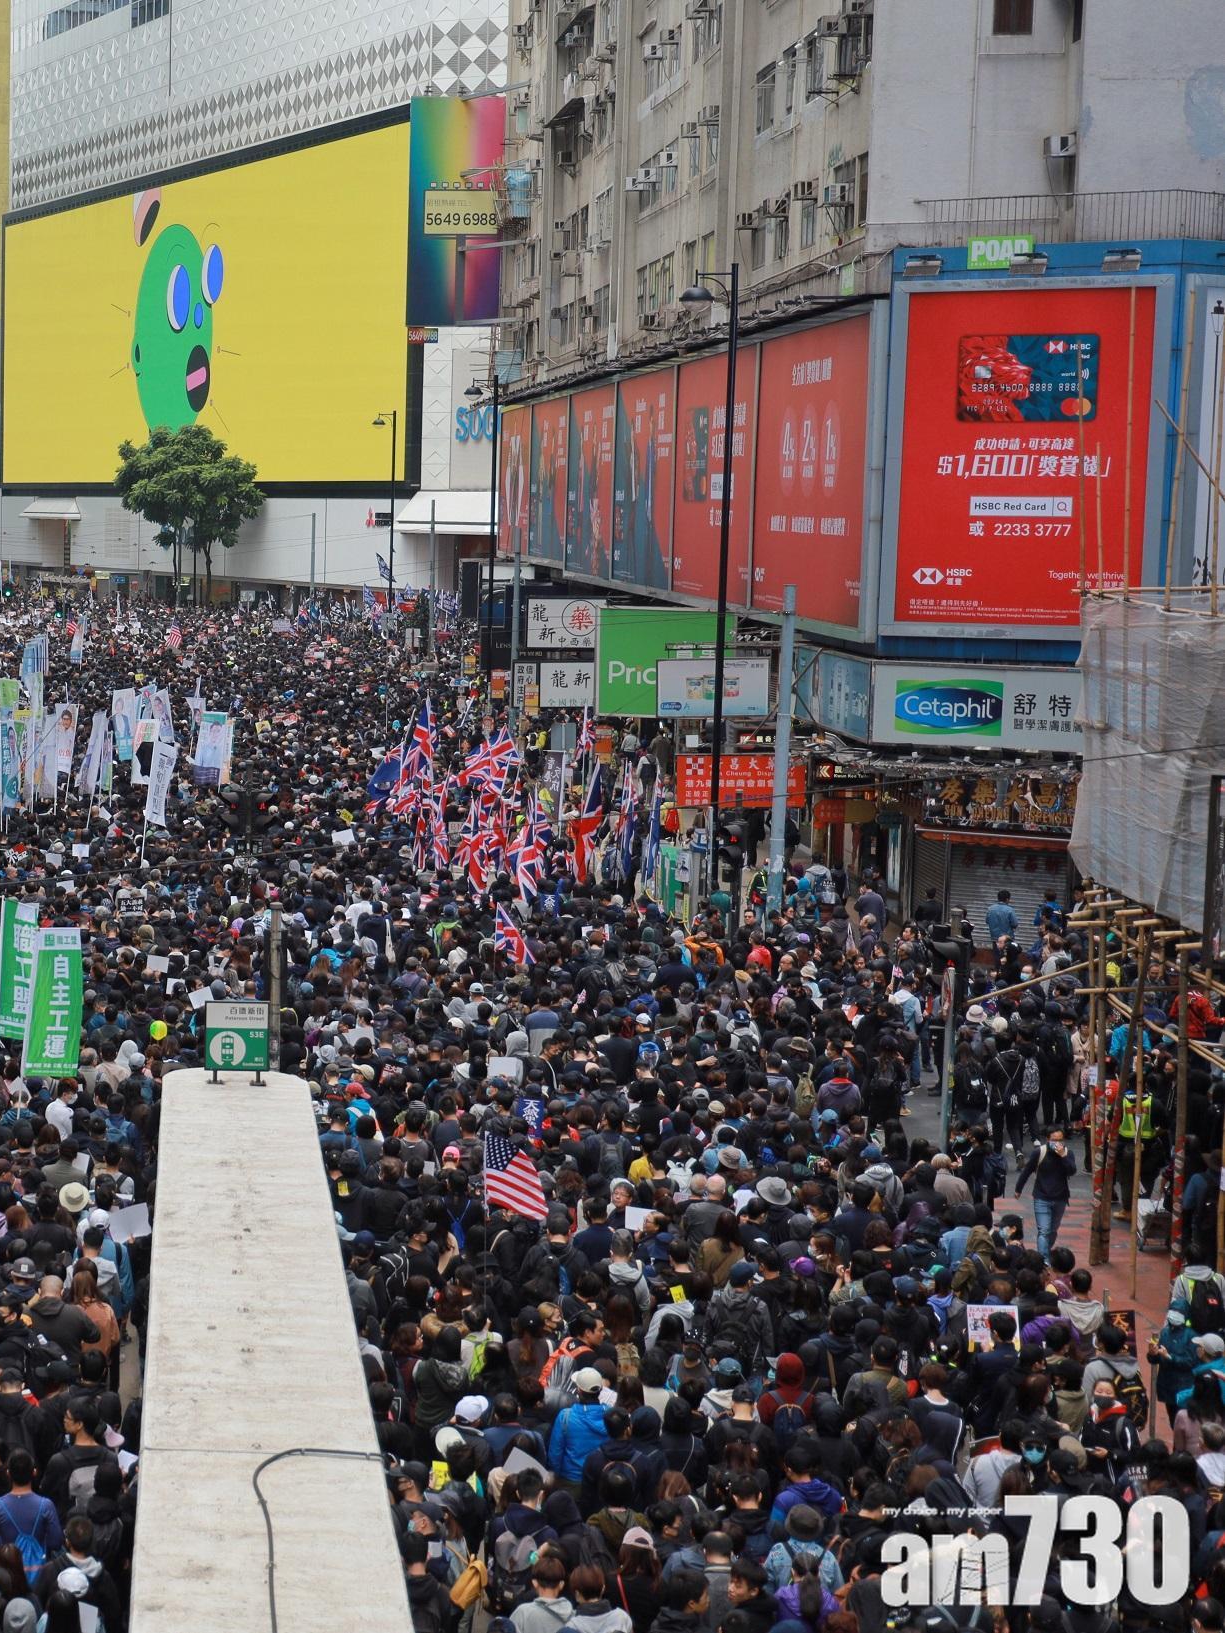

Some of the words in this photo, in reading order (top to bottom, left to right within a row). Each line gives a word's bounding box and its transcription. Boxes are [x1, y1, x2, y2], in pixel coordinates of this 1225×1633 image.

[425, 212, 461, 226] 5649
[463, 212, 497, 226] 6988
[1029, 384, 1053, 392] 8888
[974, 502, 1001, 510] HSBC
[1003, 502, 1021, 510] Red
[1025, 502, 1047, 511] Card
[969, 521, 985, 536] 或
[994, 523, 1030, 536] 2233
[1034, 524, 1072, 537] 3777
[947, 568, 973, 576] HSBC
[1049, 570, 1084, 580] Togethe
[569, 606, 593, 630] 藥
[551, 669, 591, 688] 龍新
[903, 695, 993, 722] Cetaphil
[44, 954, 71, 1059] 自主工運
